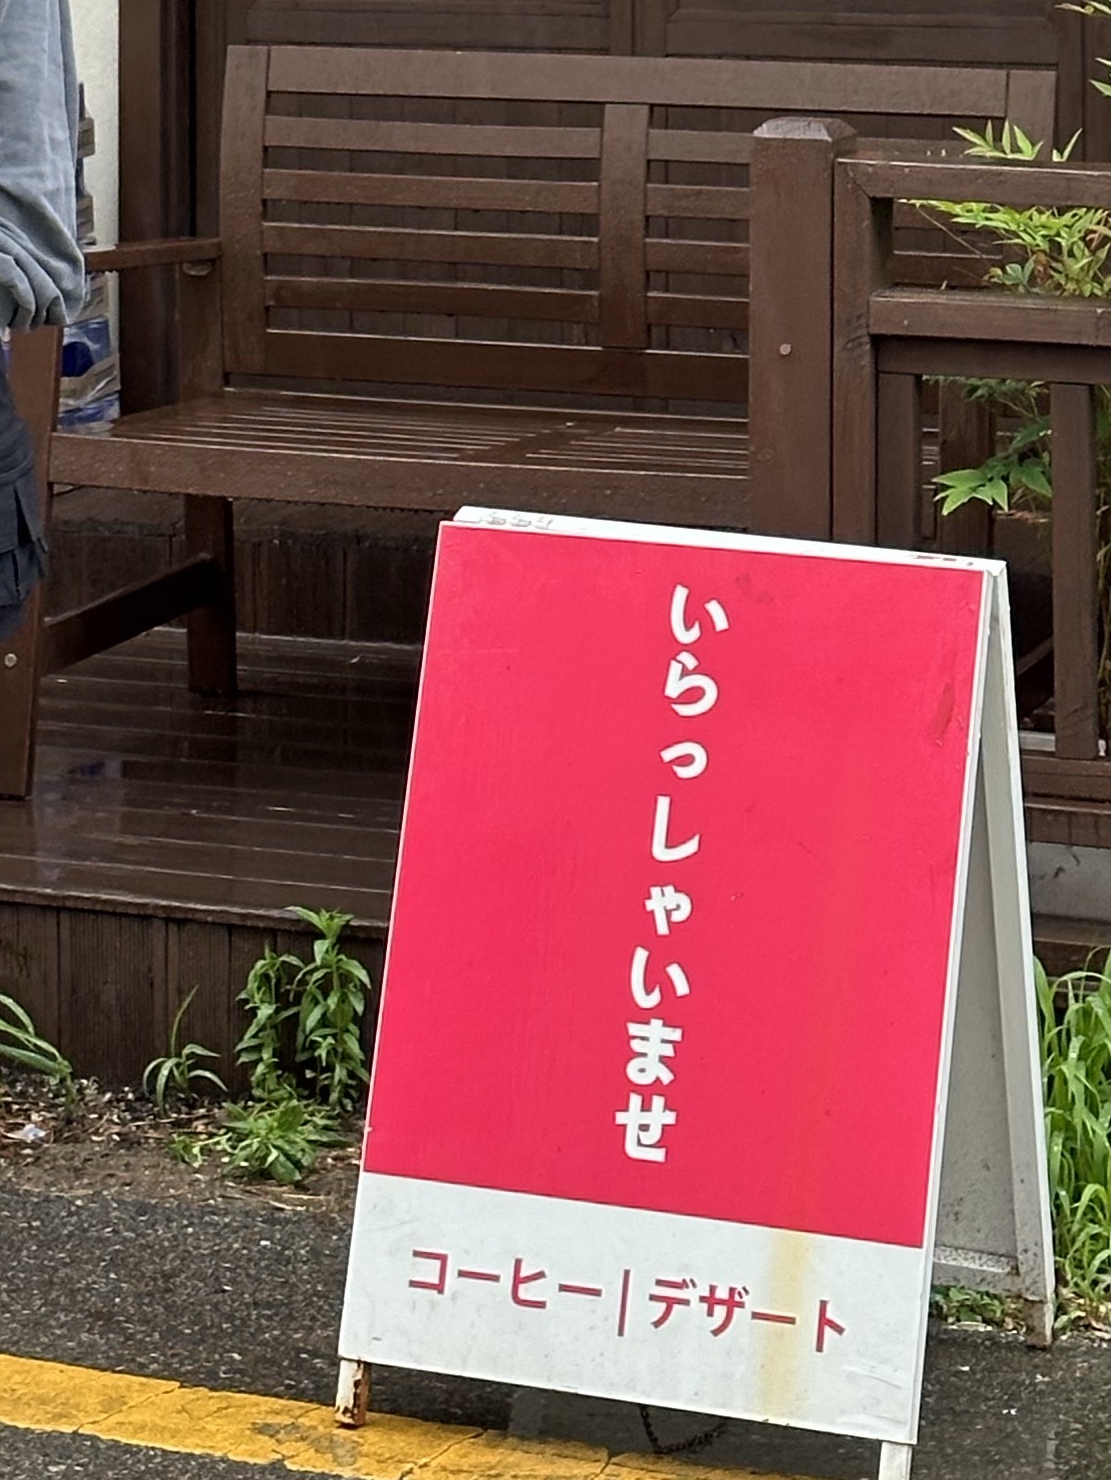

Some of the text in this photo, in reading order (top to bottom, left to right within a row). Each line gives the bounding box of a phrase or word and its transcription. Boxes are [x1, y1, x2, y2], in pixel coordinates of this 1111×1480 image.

[613, 583, 731, 1164] いらっしゃいませ
